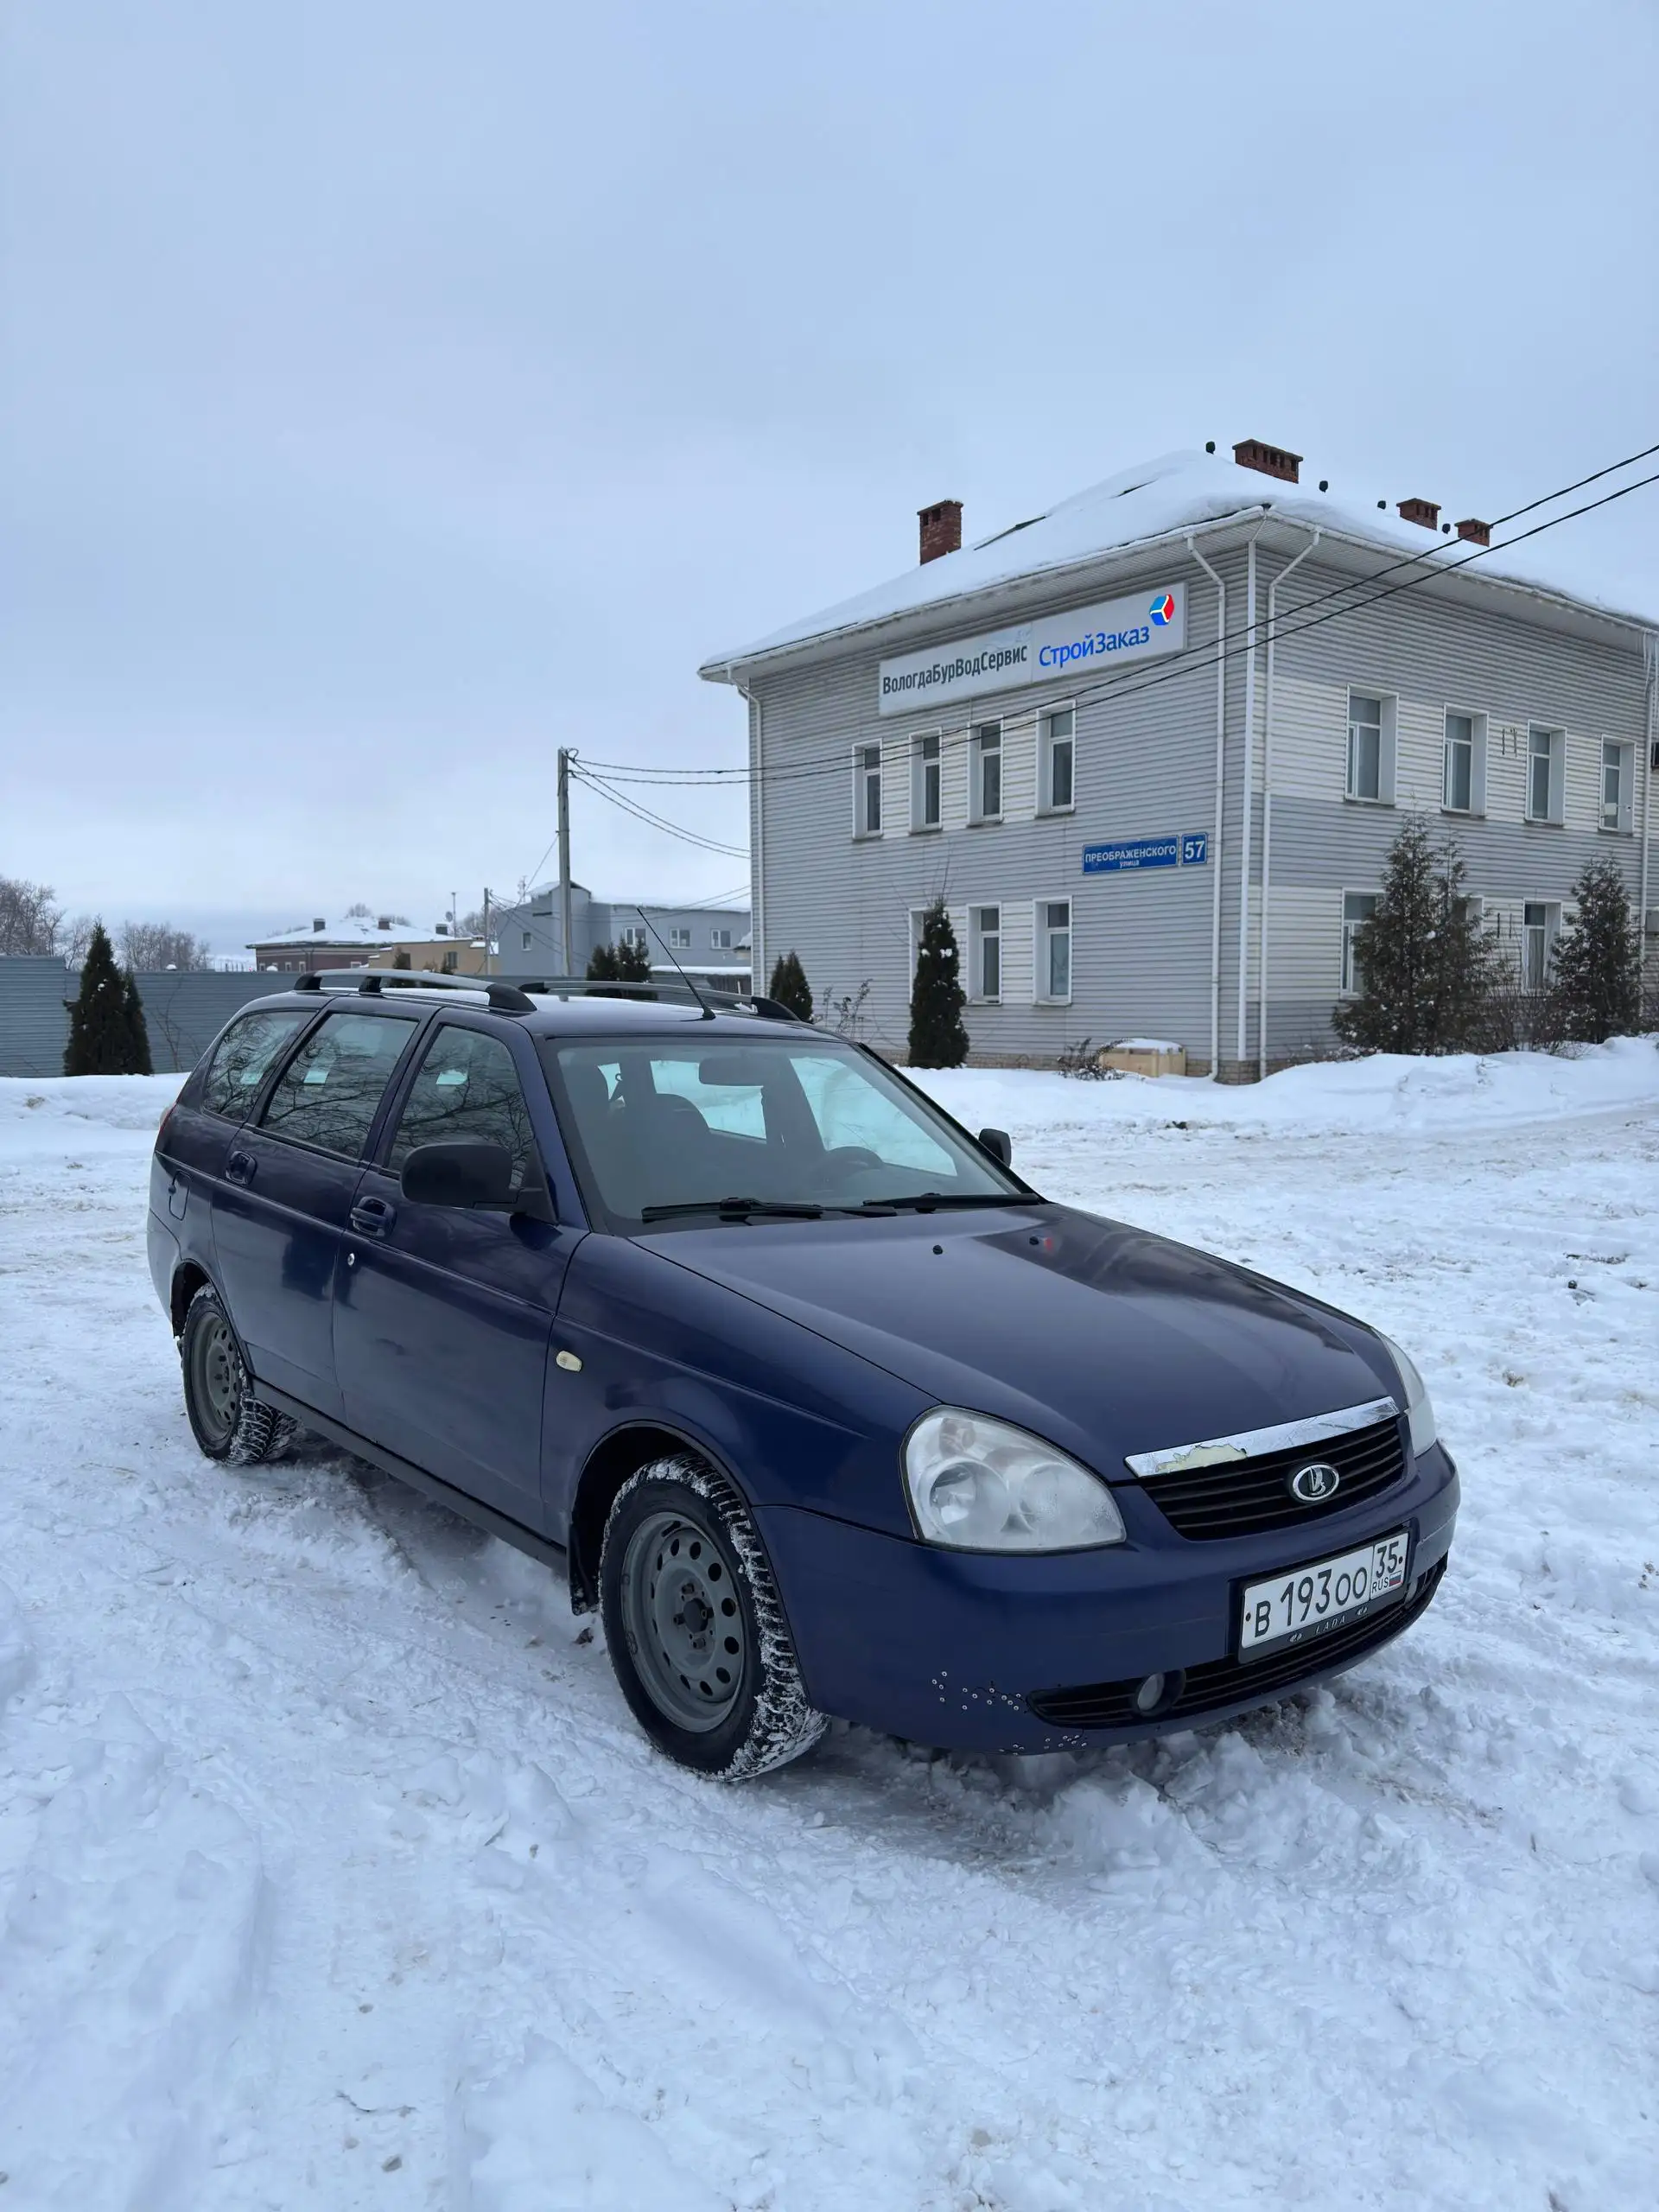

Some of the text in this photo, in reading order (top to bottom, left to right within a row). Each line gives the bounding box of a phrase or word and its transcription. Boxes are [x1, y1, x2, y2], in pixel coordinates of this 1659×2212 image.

[1039, 626, 1150, 668] СтройЗаказ
[882, 645, 1028, 695] ВологдаБурВодСервис
[1084, 845, 1177, 863] ПРЕОБРАЖЕНСКОГО
[1184, 840, 1205, 860] 57
[1376, 1541, 1400, 1579] 35
[1371, 1576, 1389, 1594] RUS
[1315, 1615, 1345, 1635] LADA
